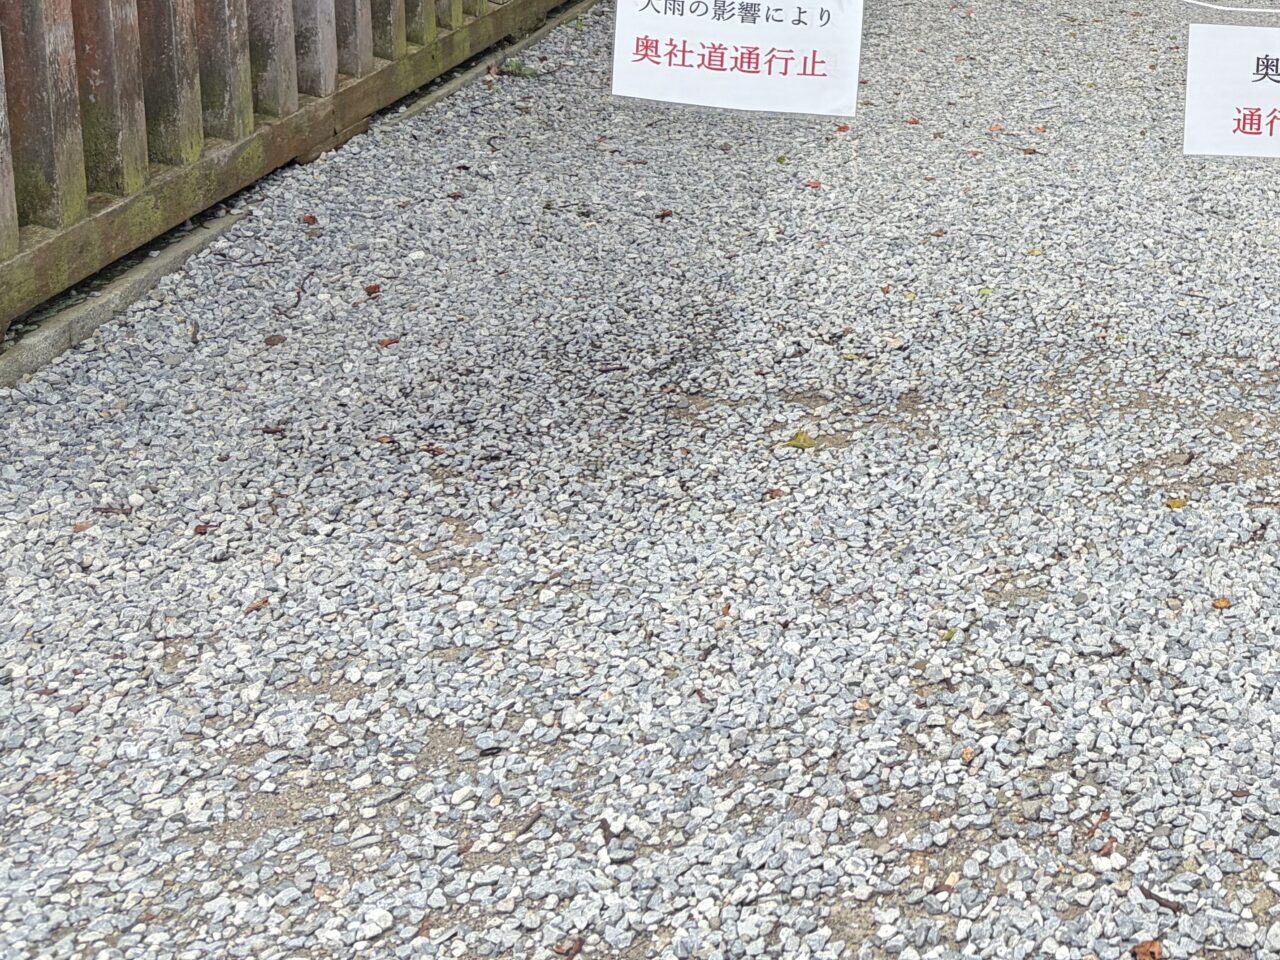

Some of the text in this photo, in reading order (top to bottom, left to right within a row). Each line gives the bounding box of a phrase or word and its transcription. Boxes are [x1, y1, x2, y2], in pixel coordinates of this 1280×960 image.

[631, 34, 829, 78] 奥社道通行止
